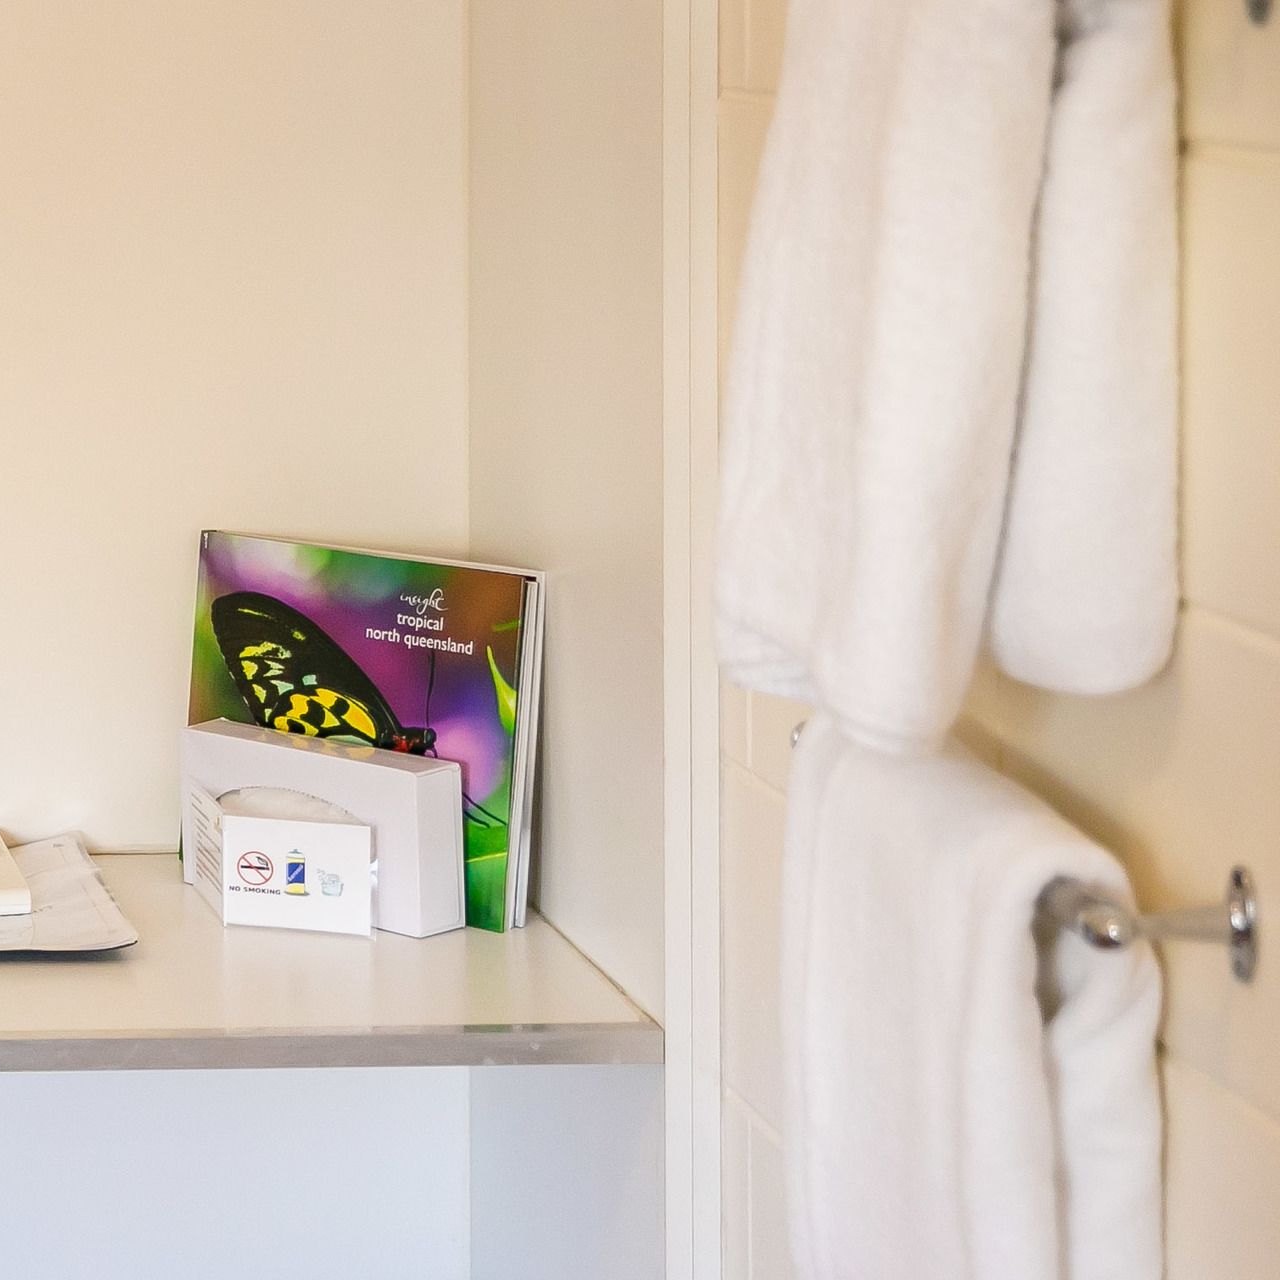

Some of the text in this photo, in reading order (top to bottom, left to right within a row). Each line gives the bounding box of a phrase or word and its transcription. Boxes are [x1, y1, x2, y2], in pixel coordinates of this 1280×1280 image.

[397, 613, 444, 631] tropical
[366, 628, 474, 655] north queensland
[243, 886, 281, 895] SMOKING
